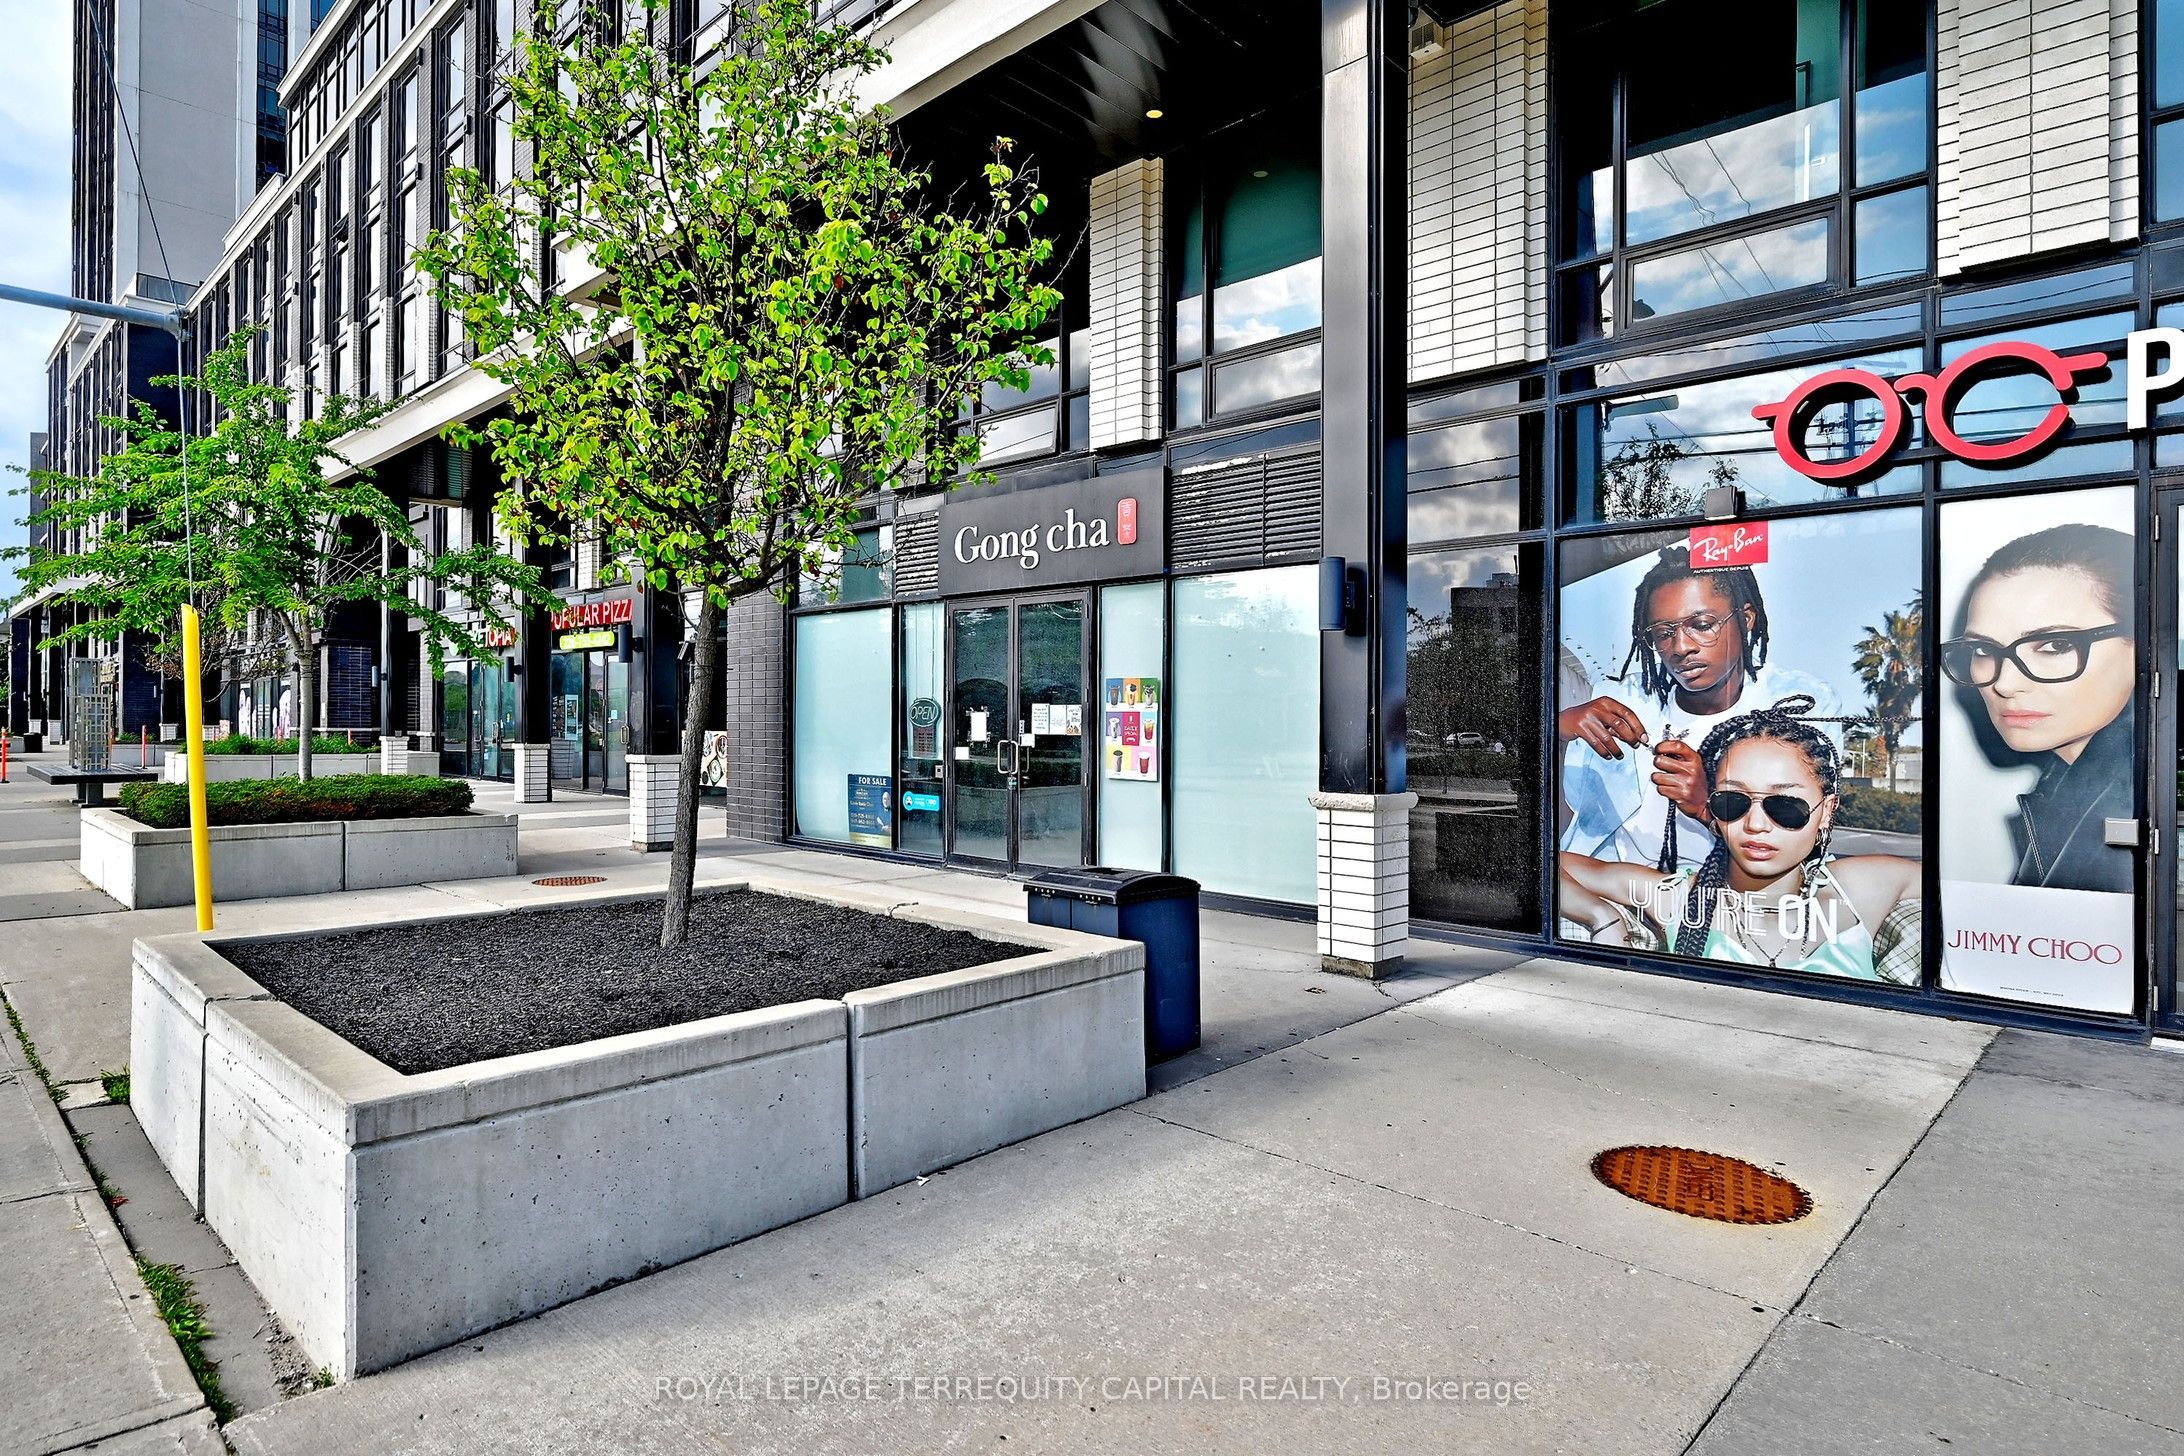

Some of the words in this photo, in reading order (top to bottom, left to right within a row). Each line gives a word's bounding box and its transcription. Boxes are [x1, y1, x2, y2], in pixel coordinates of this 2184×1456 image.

[954, 524, 1040, 570] Gong
[1046, 508, 1110, 552] cha
[1693, 527, 1763, 562] Ray-Ban
[551, 603, 600, 630] OPULAR
[911, 706, 936, 720] OPEN
[858, 776, 871, 785] FOR
[872, 777, 887, 786] SALE
[1628, 879, 1767, 937] YOU'RE
[1947, 929, 2022, 955] JIMMY
[2027, 937, 2123, 965] CHOO
